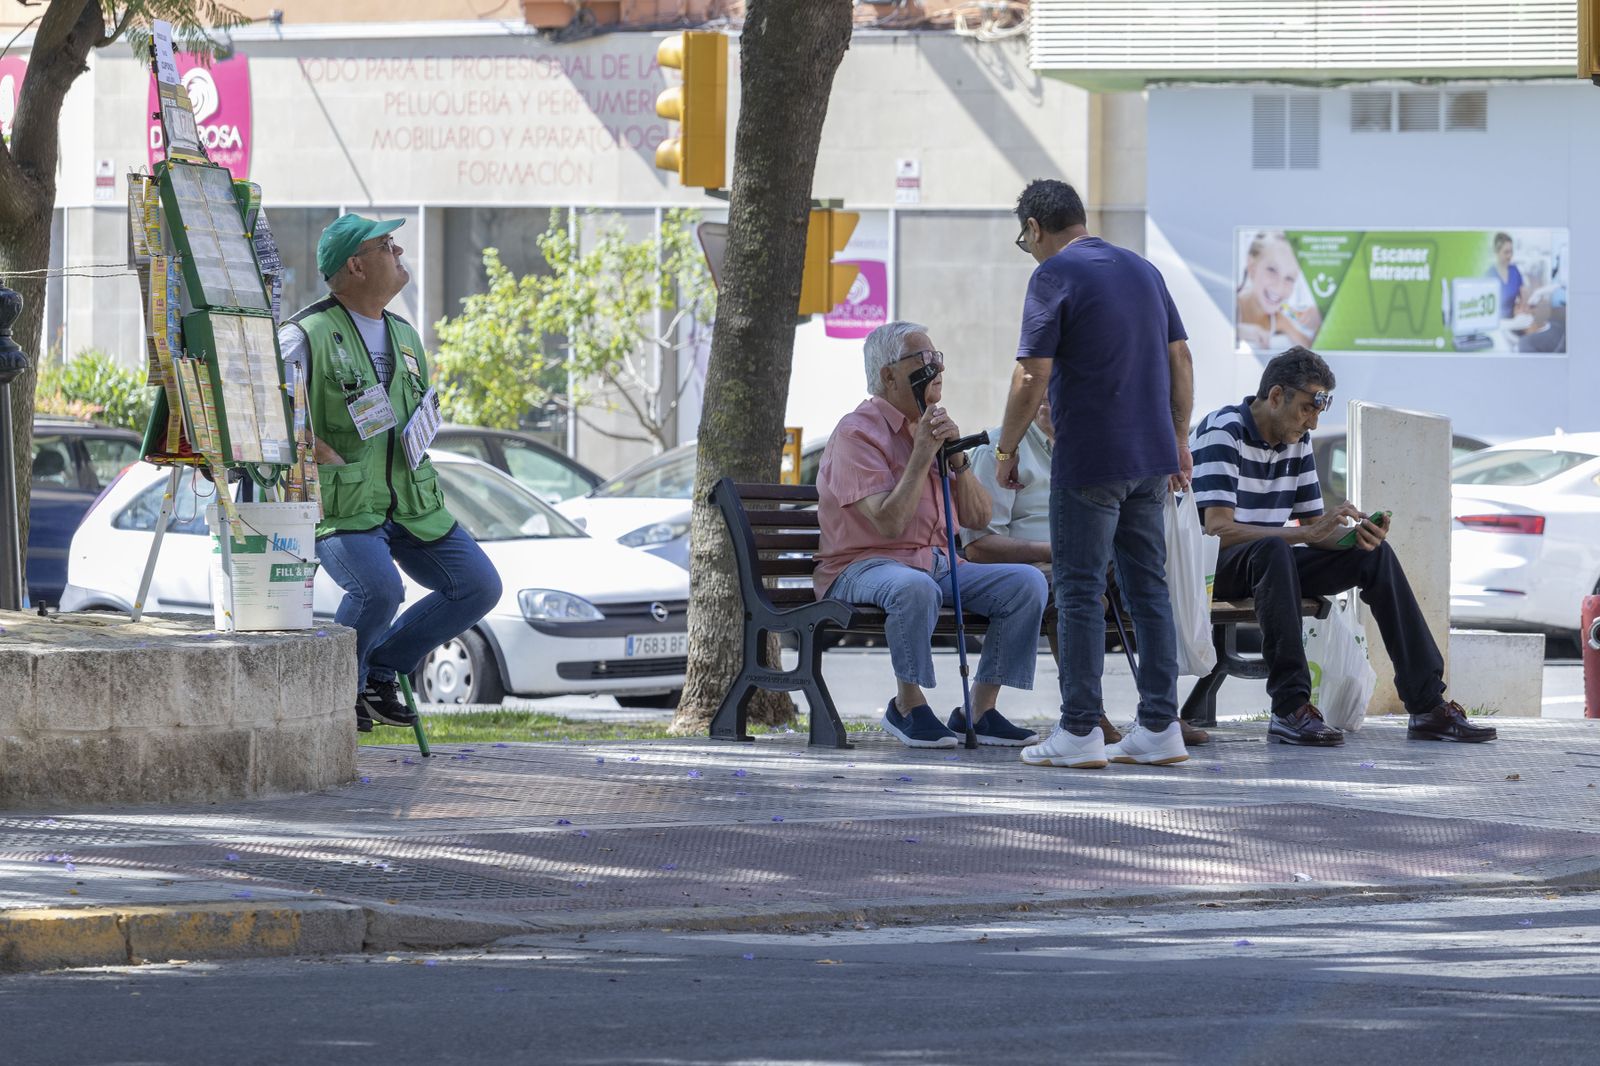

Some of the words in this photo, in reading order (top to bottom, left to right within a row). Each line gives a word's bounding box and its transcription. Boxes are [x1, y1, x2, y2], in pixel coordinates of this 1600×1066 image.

[365, 56, 419, 80] PARA
[424, 55, 443, 80] EL
[450, 53, 595, 80] PROFESIONAL
[601, 53, 630, 80] DE
[384, 86, 511, 116] PELUQUERÍA
[519, 89, 531, 113] Y
[537, 83, 657, 115] PERFUMERÍ
[371, 126, 495, 150] MOBILIARIO
[502, 126, 513, 149] Y
[520, 125, 684, 150] APARATOLOG
[457, 157, 593, 185] FORMACIÓN
[276, 567, 294, 577] FILL
[296, 567, 302, 577] &
[670, 635, 687, 652] BF
